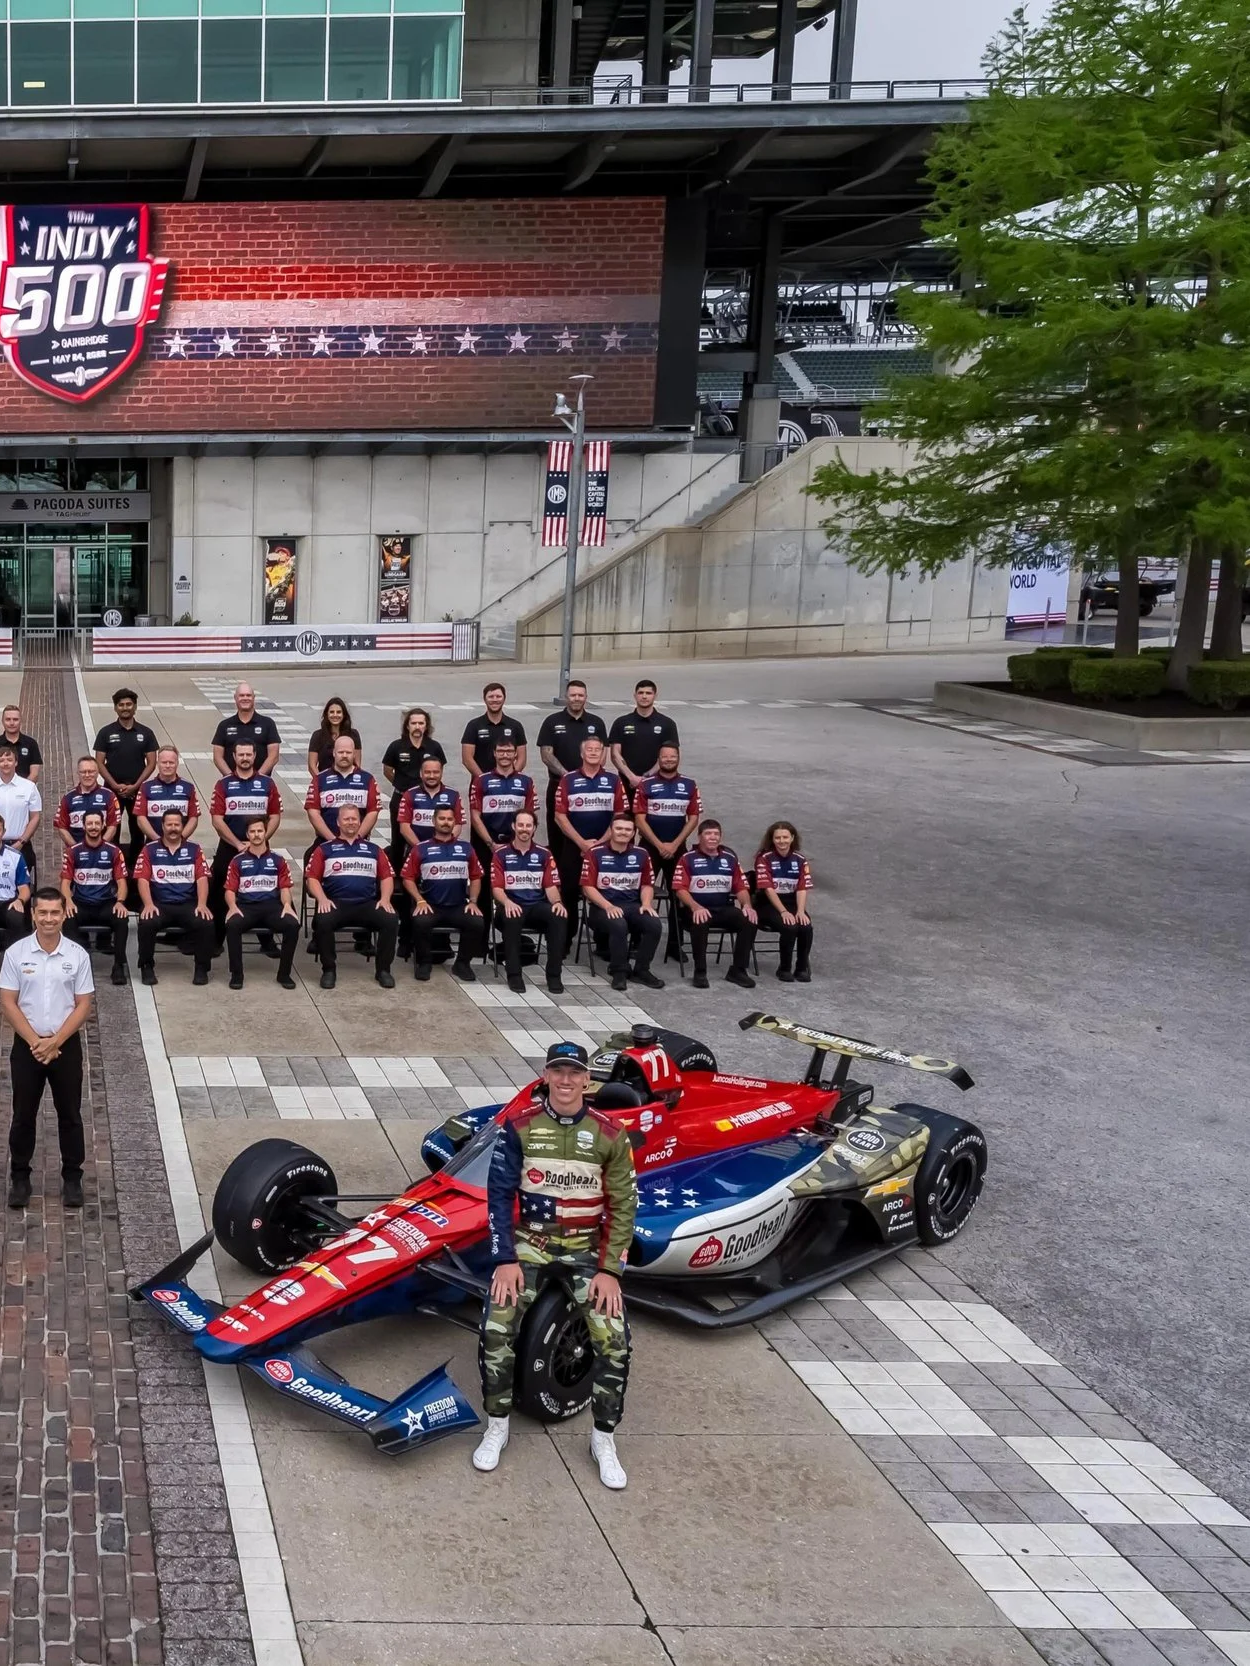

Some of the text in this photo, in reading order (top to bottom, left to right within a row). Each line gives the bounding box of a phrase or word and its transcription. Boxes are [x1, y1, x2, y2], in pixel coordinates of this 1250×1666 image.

[35, 226, 125, 261] INDY
[0, 263, 151, 338] 500
[61, 334, 109, 349] GAINBRIDGE
[52, 353, 71, 365] MAY
[34, 497, 130, 510] PAGODA SUITES
[104, 611, 122, 627] IMS
[297, 633, 321, 654] IMS
[238, 800, 265, 809] Goodheart
[335, 793, 363, 802] Goodheart
[584, 796, 611, 805] Goodheart
[342, 861, 373, 870] Goodheart
[439, 865, 466, 873] Goodheart
[166, 870, 193, 878] Goodheart
[793, 1026, 841, 1043] FREEDOM
[837, 1038, 883, 1055] SERVICE
[641, 1048, 669, 1082] 77
[681, 1053, 713, 1068] Firestone
[712, 1074, 767, 1089] JuncosHollinger.com
[850, 1136, 877, 1150] HEART
[857, 1131, 881, 1145] GOOD
[951, 1135, 983, 1156] Firestone
[645, 1150, 666, 1164] ARCO
[287, 1164, 328, 1180] Firestone
[882, 1198, 904, 1213] ARCO
[391, 1217, 430, 1249] FREEDOM
[724, 1204, 788, 1259] Goodheart
[888, 1220, 914, 1233] Firestone
[384, 1222, 421, 1253] SERVICE DOGS
[699, 1244, 719, 1257] GOOD
[692, 1255, 717, 1265] HEART
[269, 1364, 286, 1381] HEART
[273, 1361, 290, 1377] GOOD
[290, 1377, 379, 1420] Goodheart
[424, 1395, 456, 1416] FREEDOM
[428, 1407, 458, 1423] SERVICE DOGS
